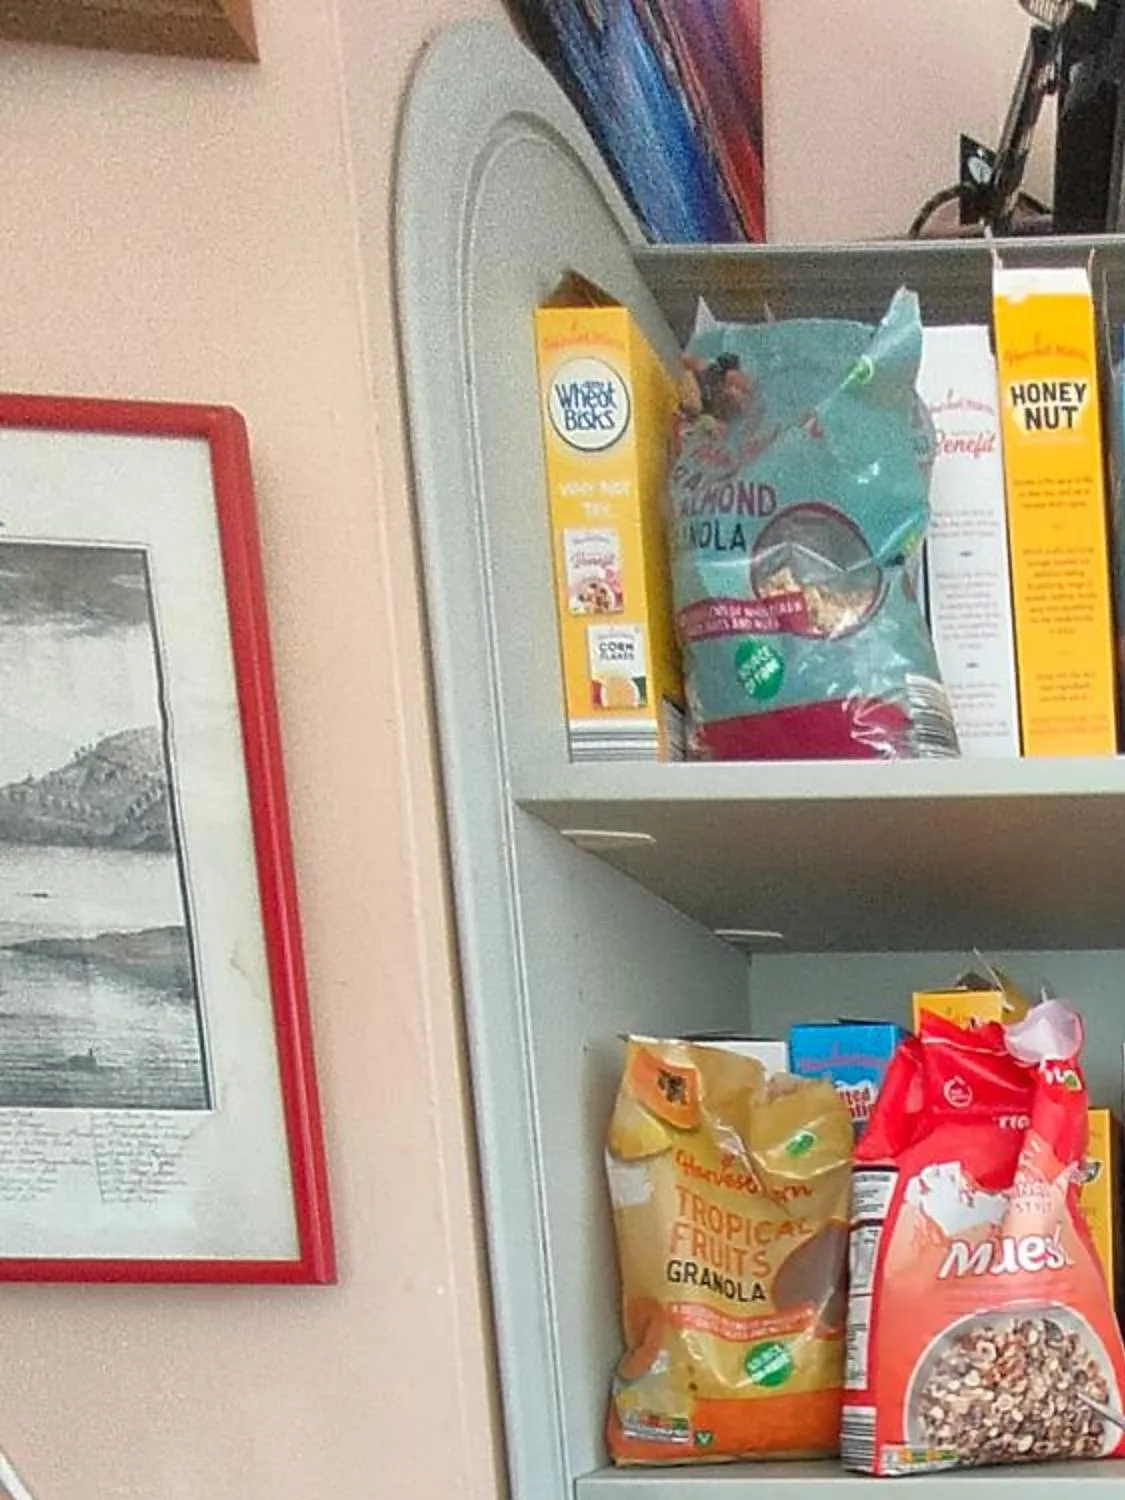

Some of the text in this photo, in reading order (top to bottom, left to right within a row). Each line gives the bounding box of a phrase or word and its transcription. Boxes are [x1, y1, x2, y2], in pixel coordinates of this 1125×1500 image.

[1010, 381, 1087, 406] HONEY
[1024, 405, 1079, 430] NUT
[676, 1184, 815, 1246] TROPICAL
[671, 1221, 772, 1279] FRUITS
[667, 1259, 767, 1303] GRANOLA
